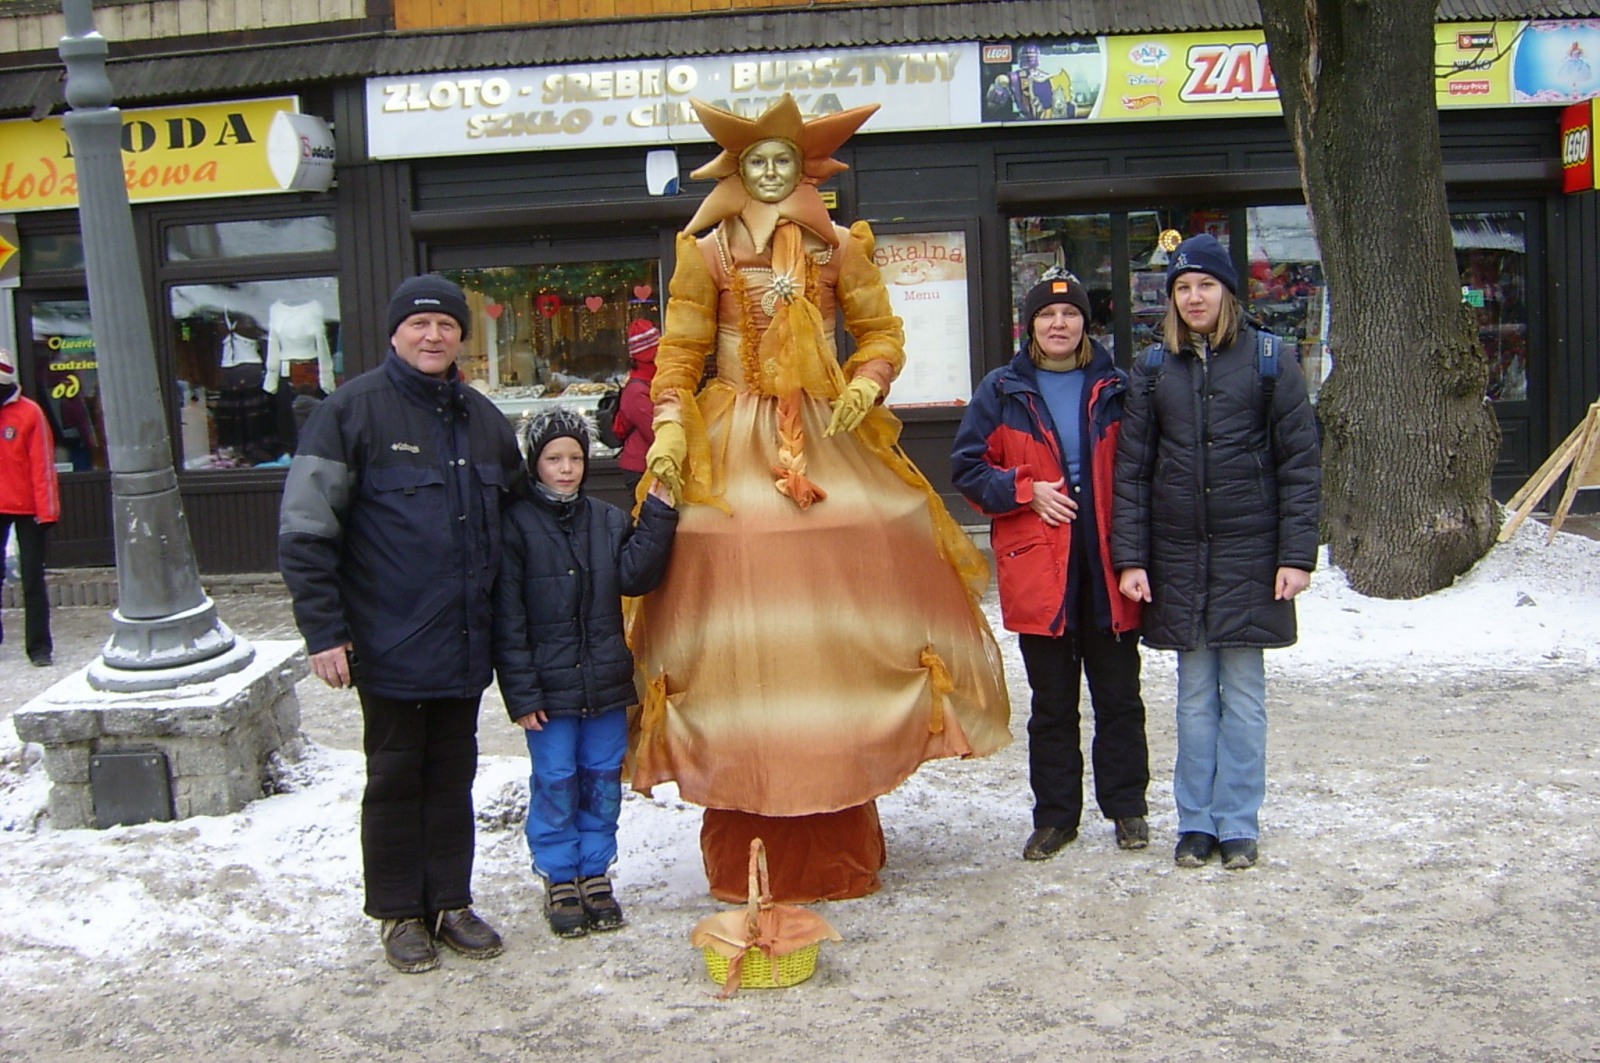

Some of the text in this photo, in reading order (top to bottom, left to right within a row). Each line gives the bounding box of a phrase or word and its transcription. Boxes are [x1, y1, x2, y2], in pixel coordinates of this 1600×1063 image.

[986, 48, 1010, 60] LEGO
[382, 78, 511, 113] ZŁOTO
[542, 65, 698, 104] SREBRO
[731, 52, 961, 93] BURSZTYNY
[62, 112, 256, 159] ODA
[466, 109, 593, 138] SZKŁO
[1562, 127, 1589, 165] LEGO
[873, 240, 964, 268] Skalna
[904, 290, 940, 301] Menu
[49, 361, 99, 371] codzie
[52, 374, 80, 399] od
